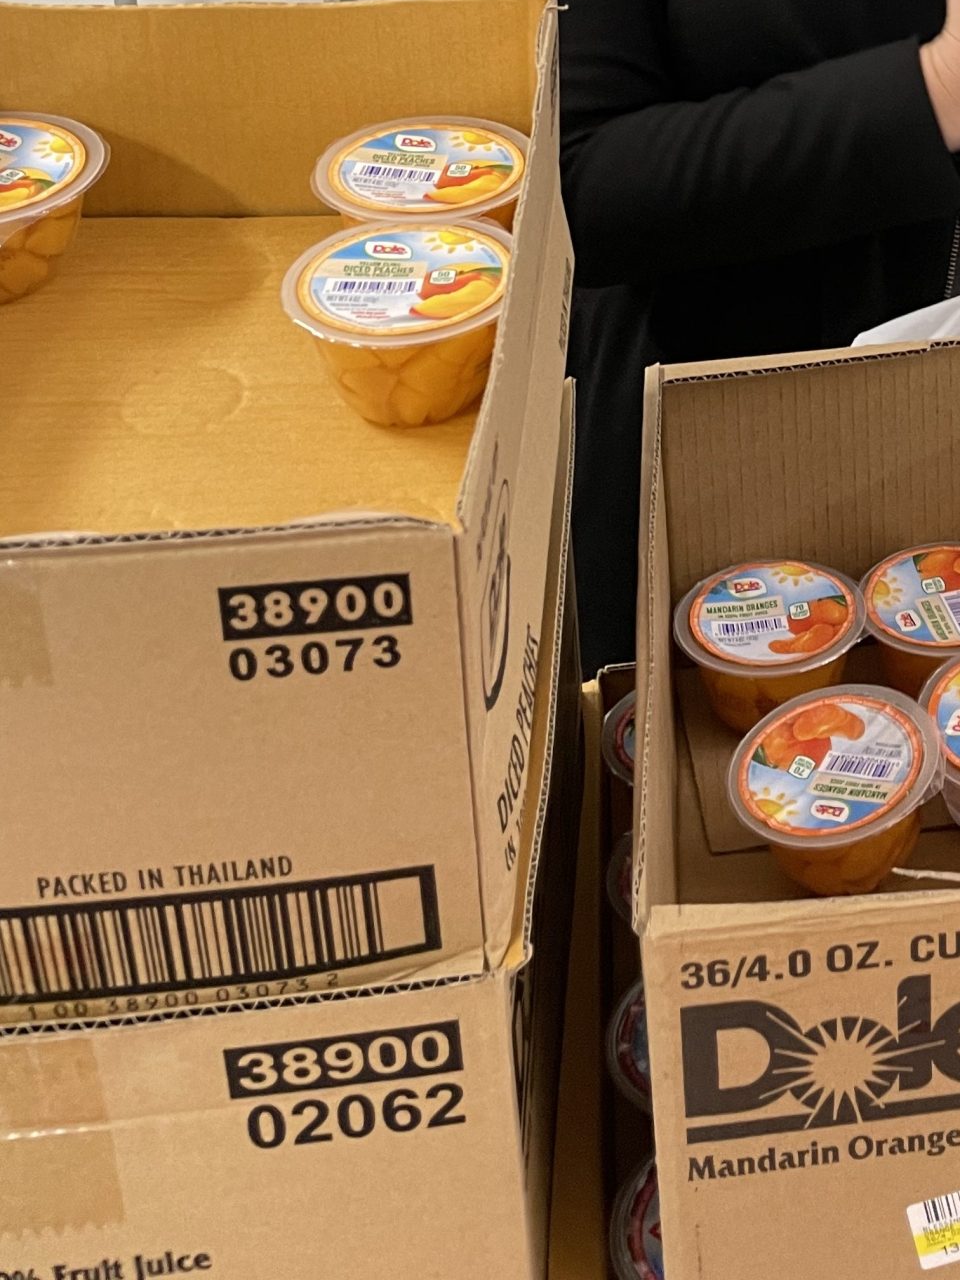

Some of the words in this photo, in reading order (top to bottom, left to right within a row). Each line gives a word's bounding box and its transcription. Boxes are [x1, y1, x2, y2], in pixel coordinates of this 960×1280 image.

[401, 137, 432, 148] Dole
[372, 244, 407, 255] Dole
[343, 265, 371, 273] DICED
[374, 265, 414, 274] PEACHES
[733, 581, 762, 593] Dole
[228, 581, 404, 631] 38900
[706, 604, 744, 615] MANDARIN
[746, 600, 778, 611] ORANGES
[228, 634, 402, 681] 03073
[497, 734, 525, 834] DICED
[813, 783, 848, 795] ORANGES
[847, 789, 888, 800] MANDARIN
[37, 871, 128, 898] PACKED
[138, 868, 164, 890] IN
[173, 855, 294, 888] THAILAND
[680, 949, 812, 990] 36/4.0
[826, 940, 893, 972] OZ.
[106, 989, 199, 1013] 38900
[216, 976, 310, 1001] 03073
[237, 1030, 451, 1091] 38900
[247, 1082, 467, 1150] 02062
[688, 1140, 840, 1182] Mandarin
[135, 1250, 212, 1280] Juice
[942, 1242, 960, 1255] 13
